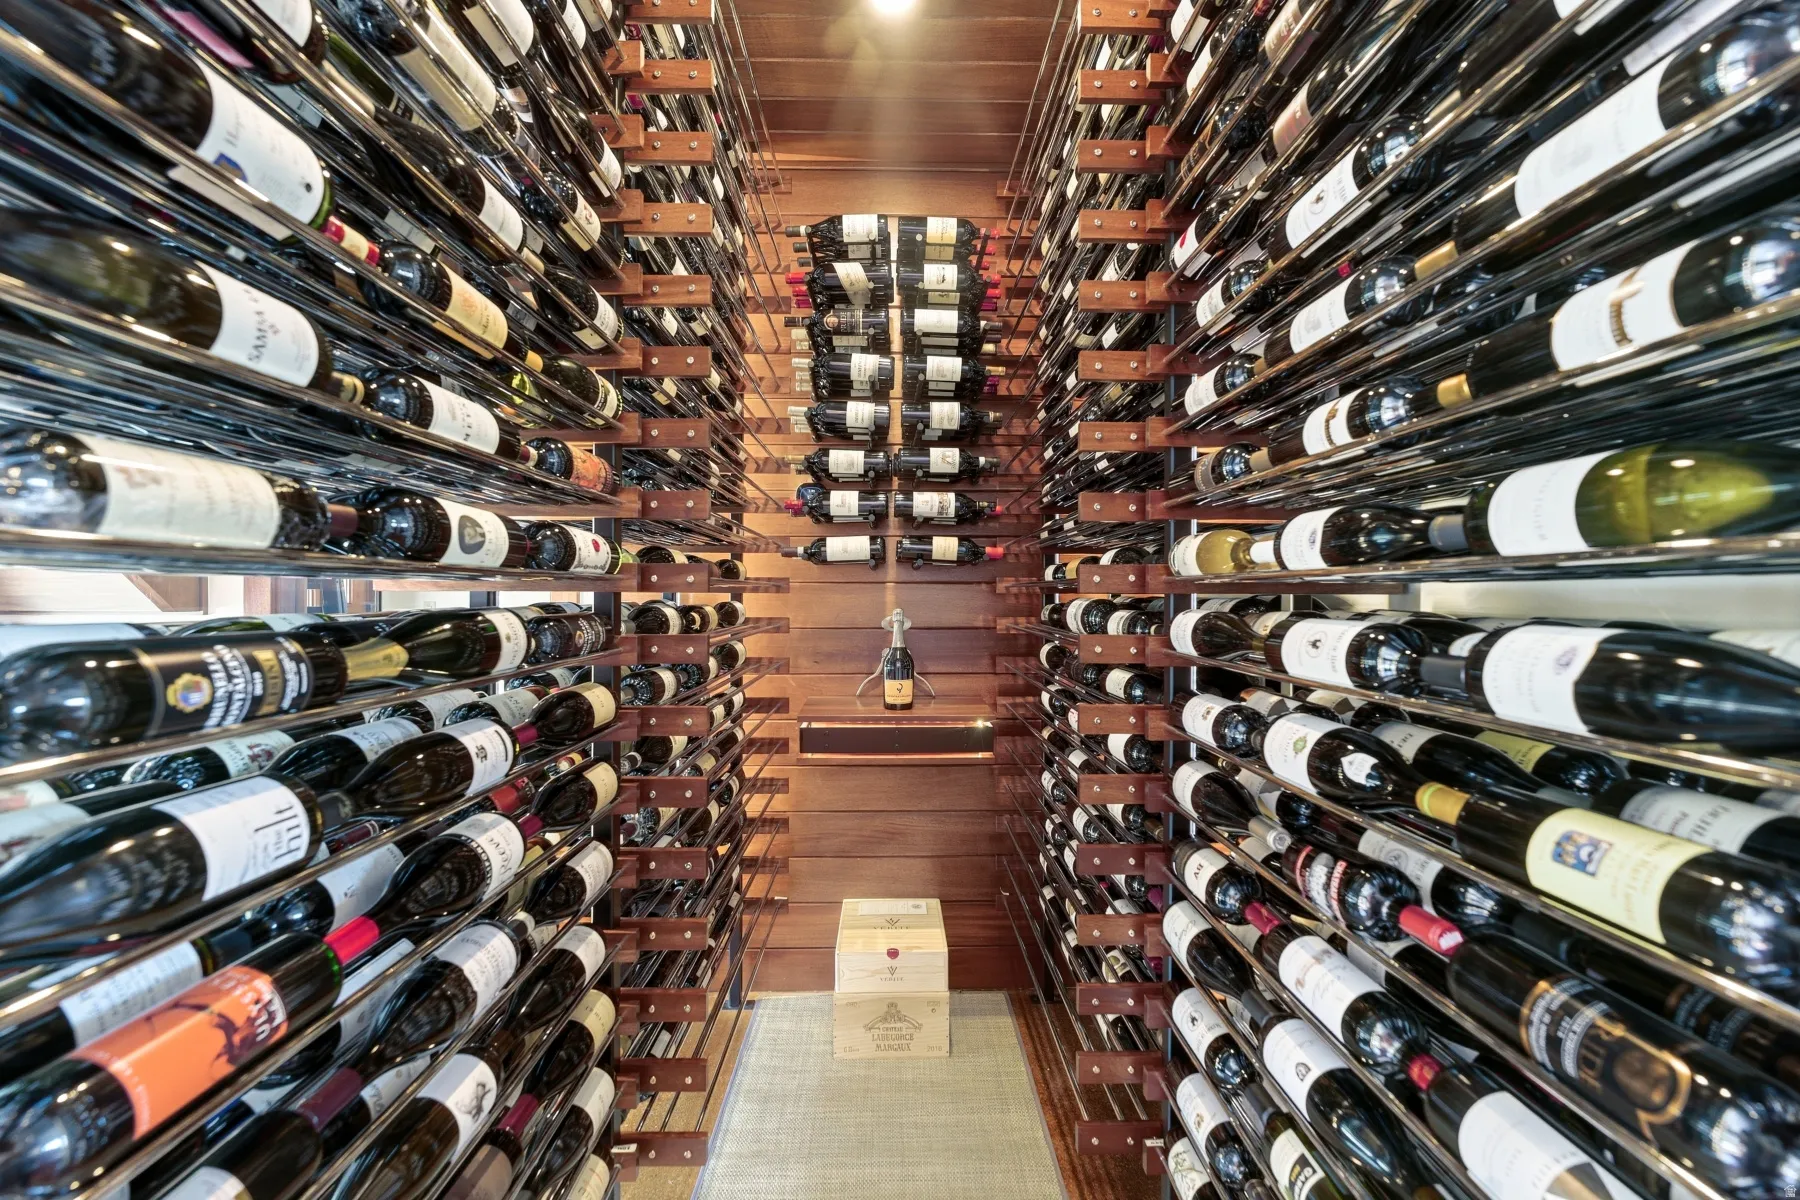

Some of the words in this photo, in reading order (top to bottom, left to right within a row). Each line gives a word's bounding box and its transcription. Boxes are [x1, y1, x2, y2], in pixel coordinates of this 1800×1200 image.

[1193, 862, 1204, 881] BV
[872, 1033, 914, 1042] LABEGORCE
[875, 1043, 911, 1052] MARGAUX
